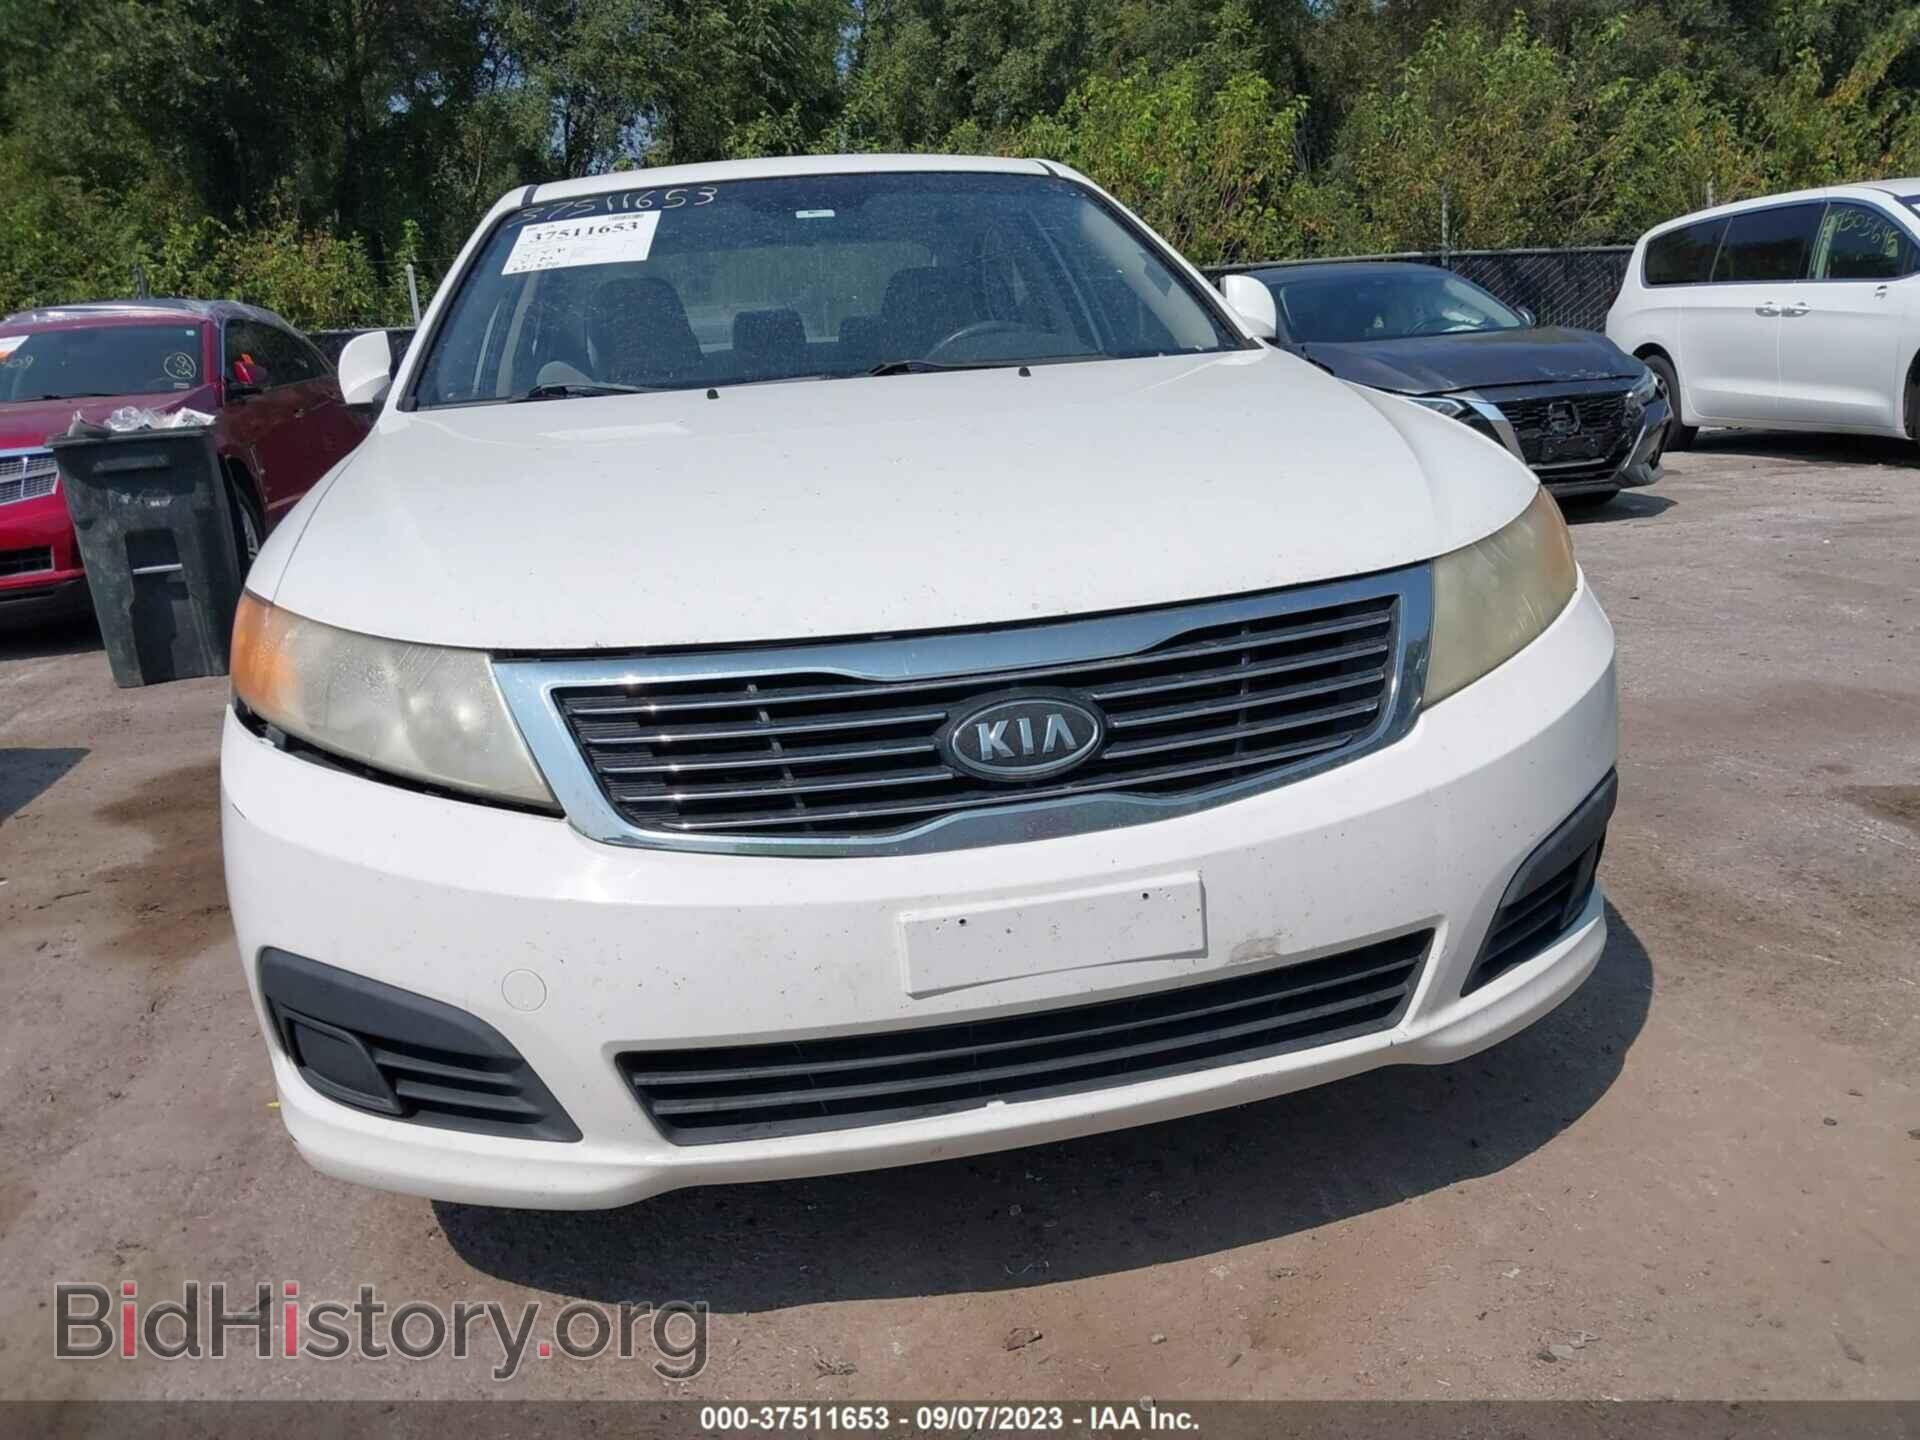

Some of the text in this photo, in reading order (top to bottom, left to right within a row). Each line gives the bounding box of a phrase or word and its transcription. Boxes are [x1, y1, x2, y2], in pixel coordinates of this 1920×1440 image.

[507, 186, 719, 228] 37511653
[529, 222, 638, 243] 37511653
[975, 713, 1078, 761] KIA
